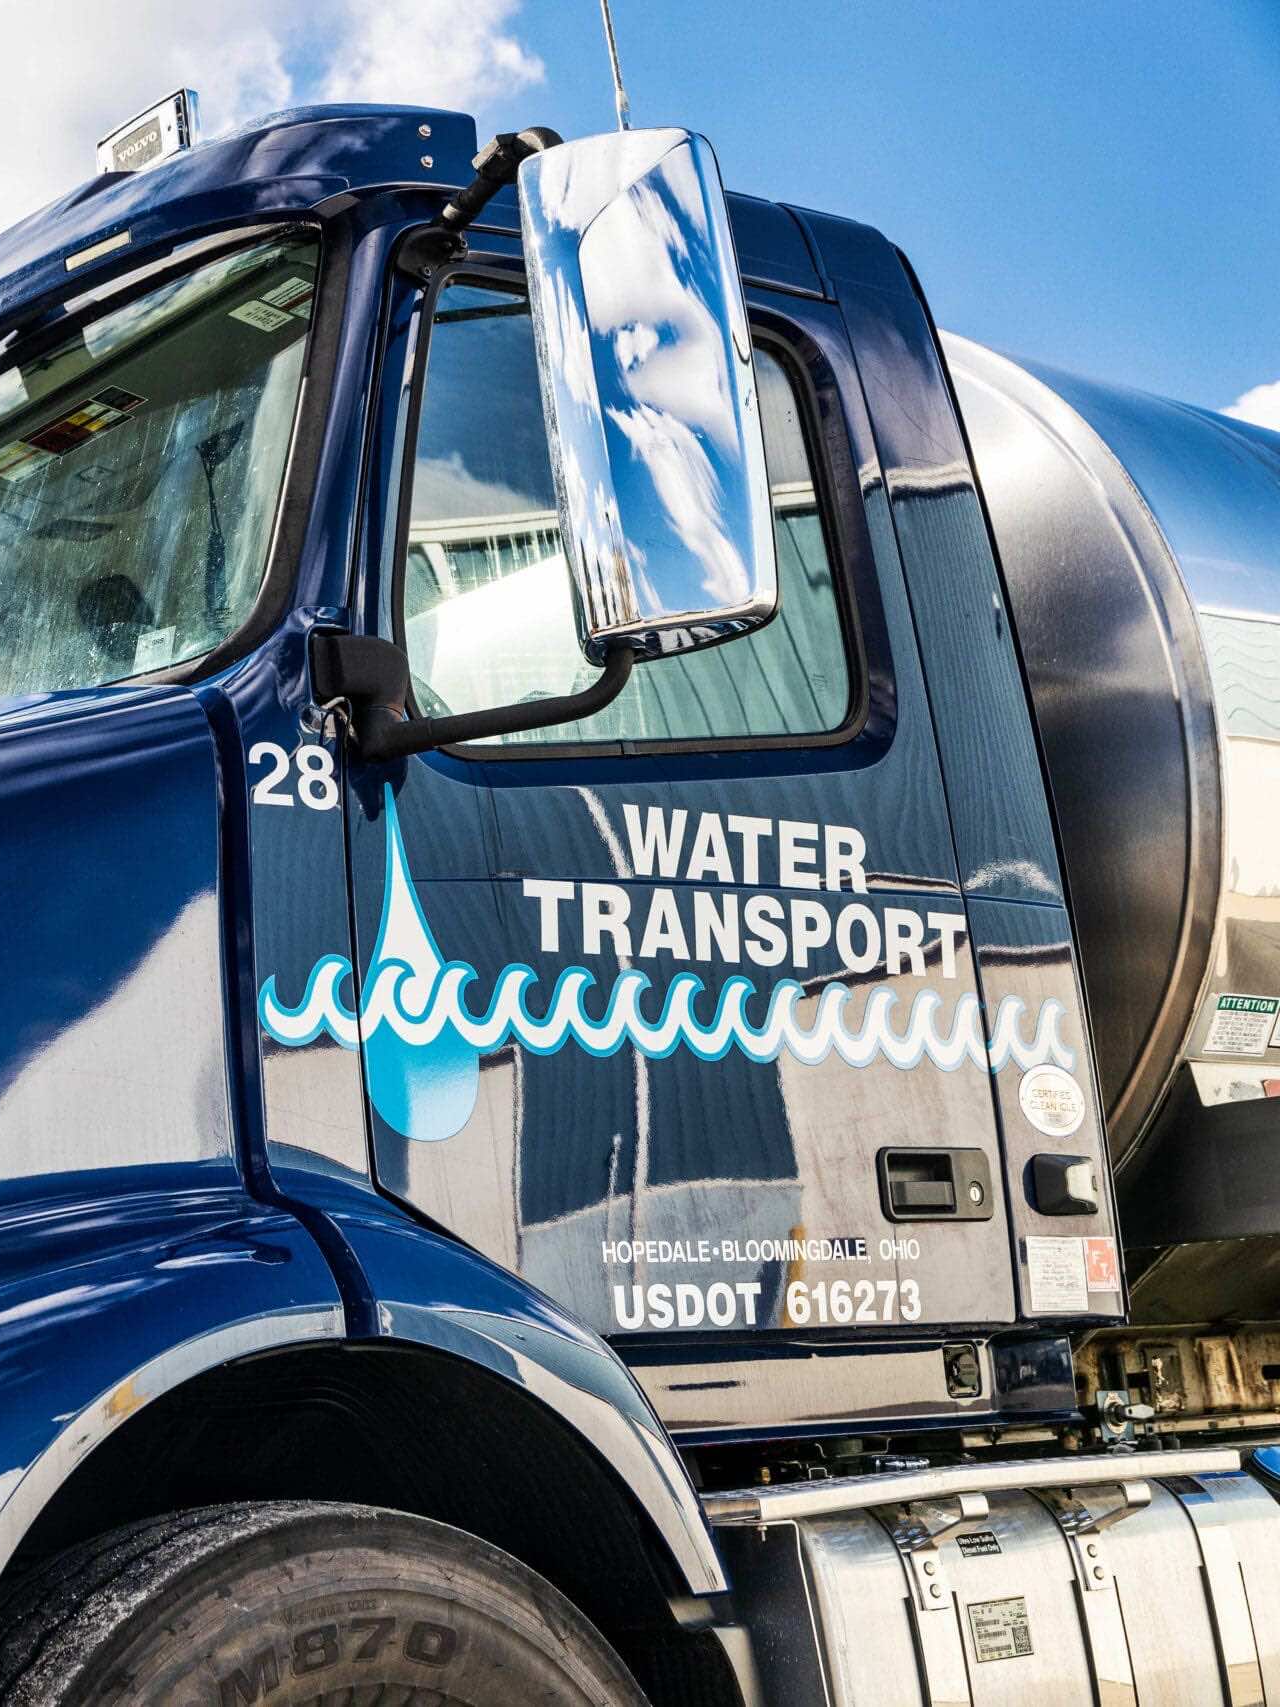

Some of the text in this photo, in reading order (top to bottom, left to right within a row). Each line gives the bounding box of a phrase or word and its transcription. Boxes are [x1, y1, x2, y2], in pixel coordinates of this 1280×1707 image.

[117, 131, 158, 162] VOLVO
[248, 741, 340, 811] 28
[622, 803, 871, 894] WATER
[523, 879, 966, 979] TRANSPORT
[1220, 997, 1276, 1012] ATTENTION
[879, 1238, 921, 1261] OHIO
[613, 1279, 922, 1330] USDOT 616273
[217, 1616, 458, 1707] M870
